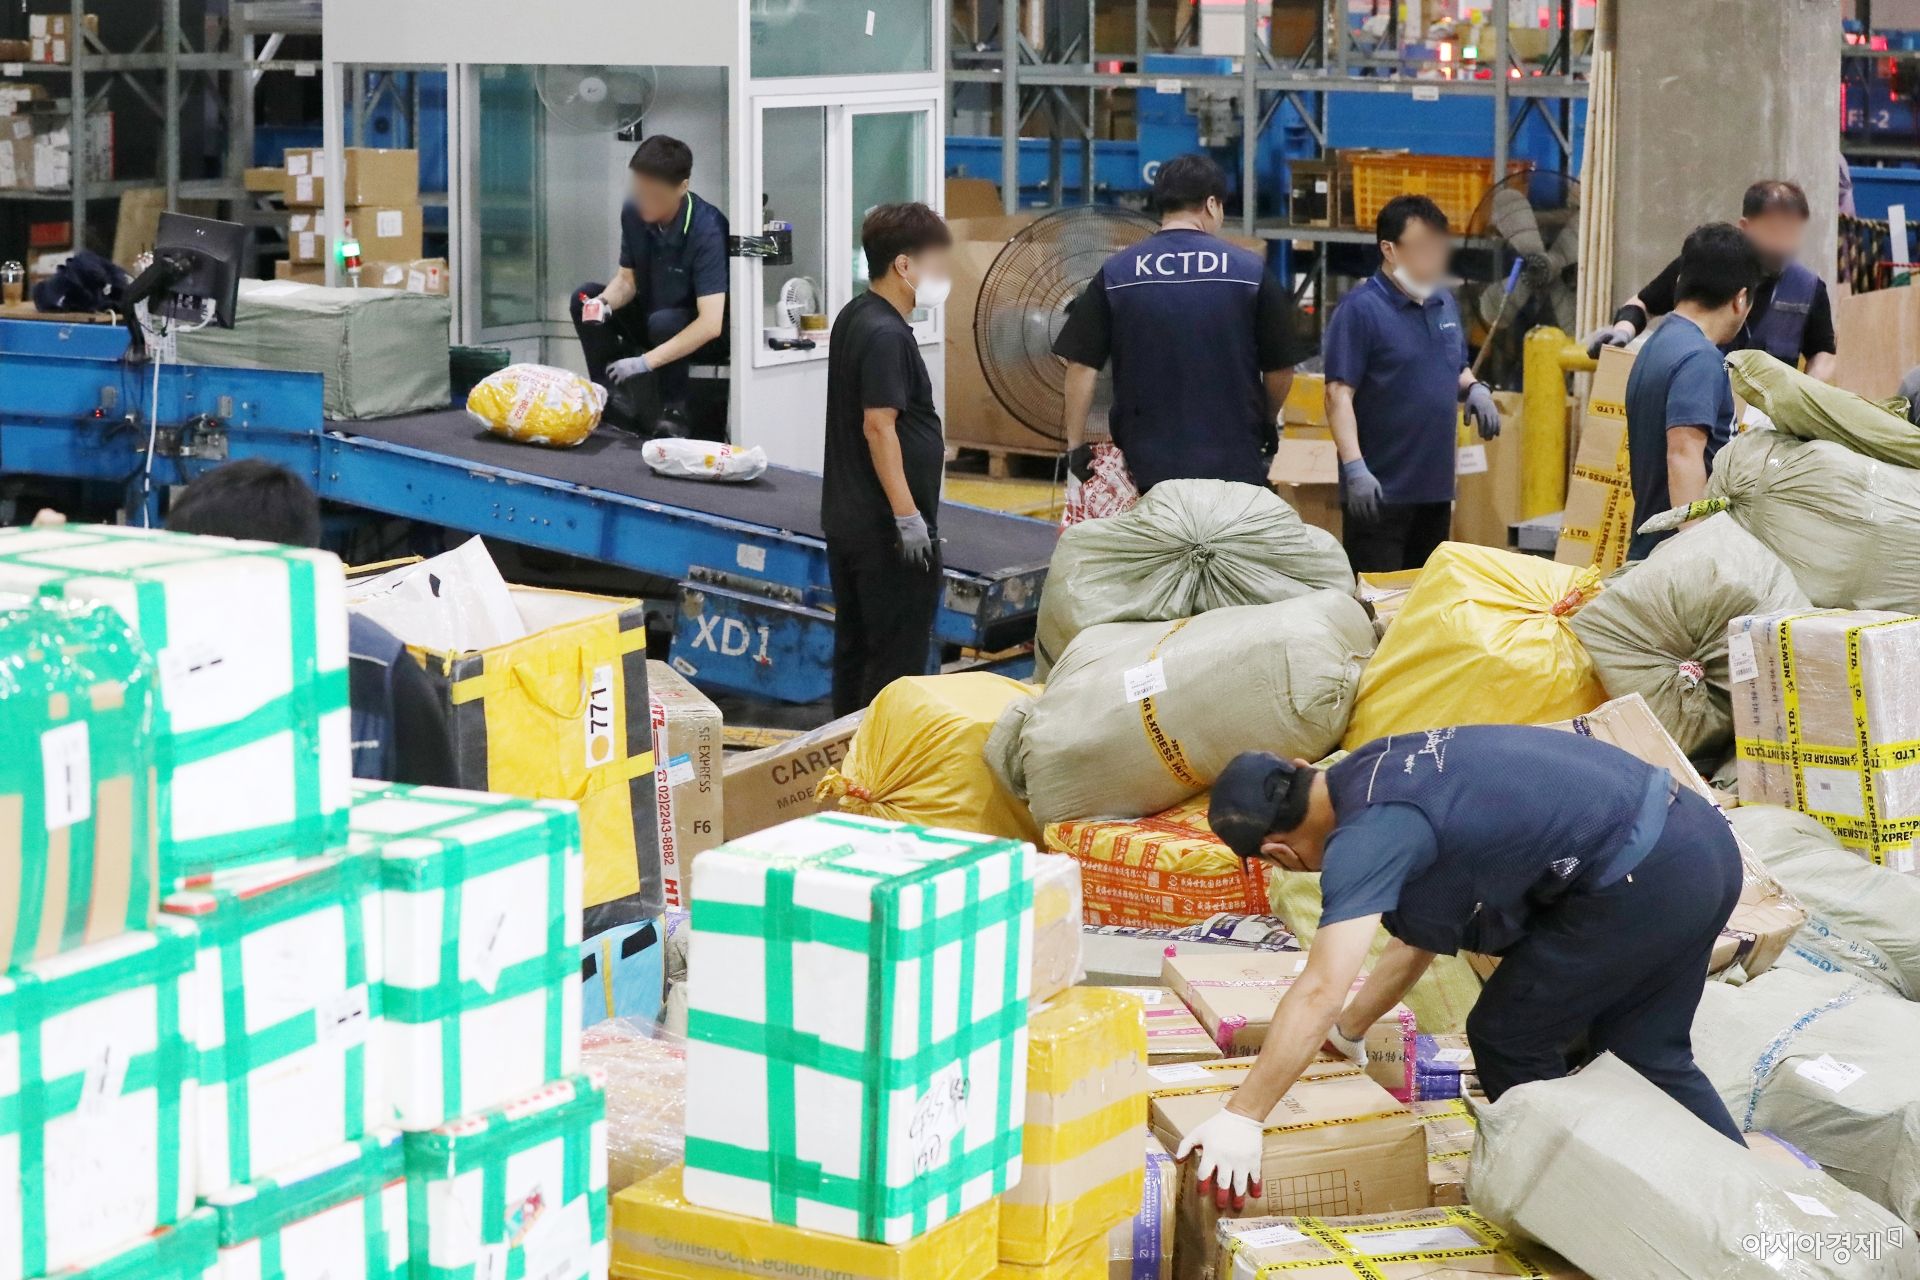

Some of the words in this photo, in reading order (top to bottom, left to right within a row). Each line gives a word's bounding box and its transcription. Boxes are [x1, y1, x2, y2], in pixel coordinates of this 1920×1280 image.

[1135, 251, 1228, 277] KCTDI
[691, 613, 773, 665] XD1
[590, 687, 608, 734] 771
[1788, 707, 1798, 734] LTD.
[699, 746, 712, 793] EXPRESS
[1814, 753, 1850, 766] NEWSTAR
[1860, 731, 1873, 792] NEWSTAR
[777, 787, 815, 810] MADE
[657, 785, 675, 866] 02)2243-8882
[693, 820, 712, 835] F6
[1837, 827, 1869, 839] NEWSTA
[1866, 795, 1881, 853] EXPRESS
[1368, 1048, 1409, 1066] 中韩快
